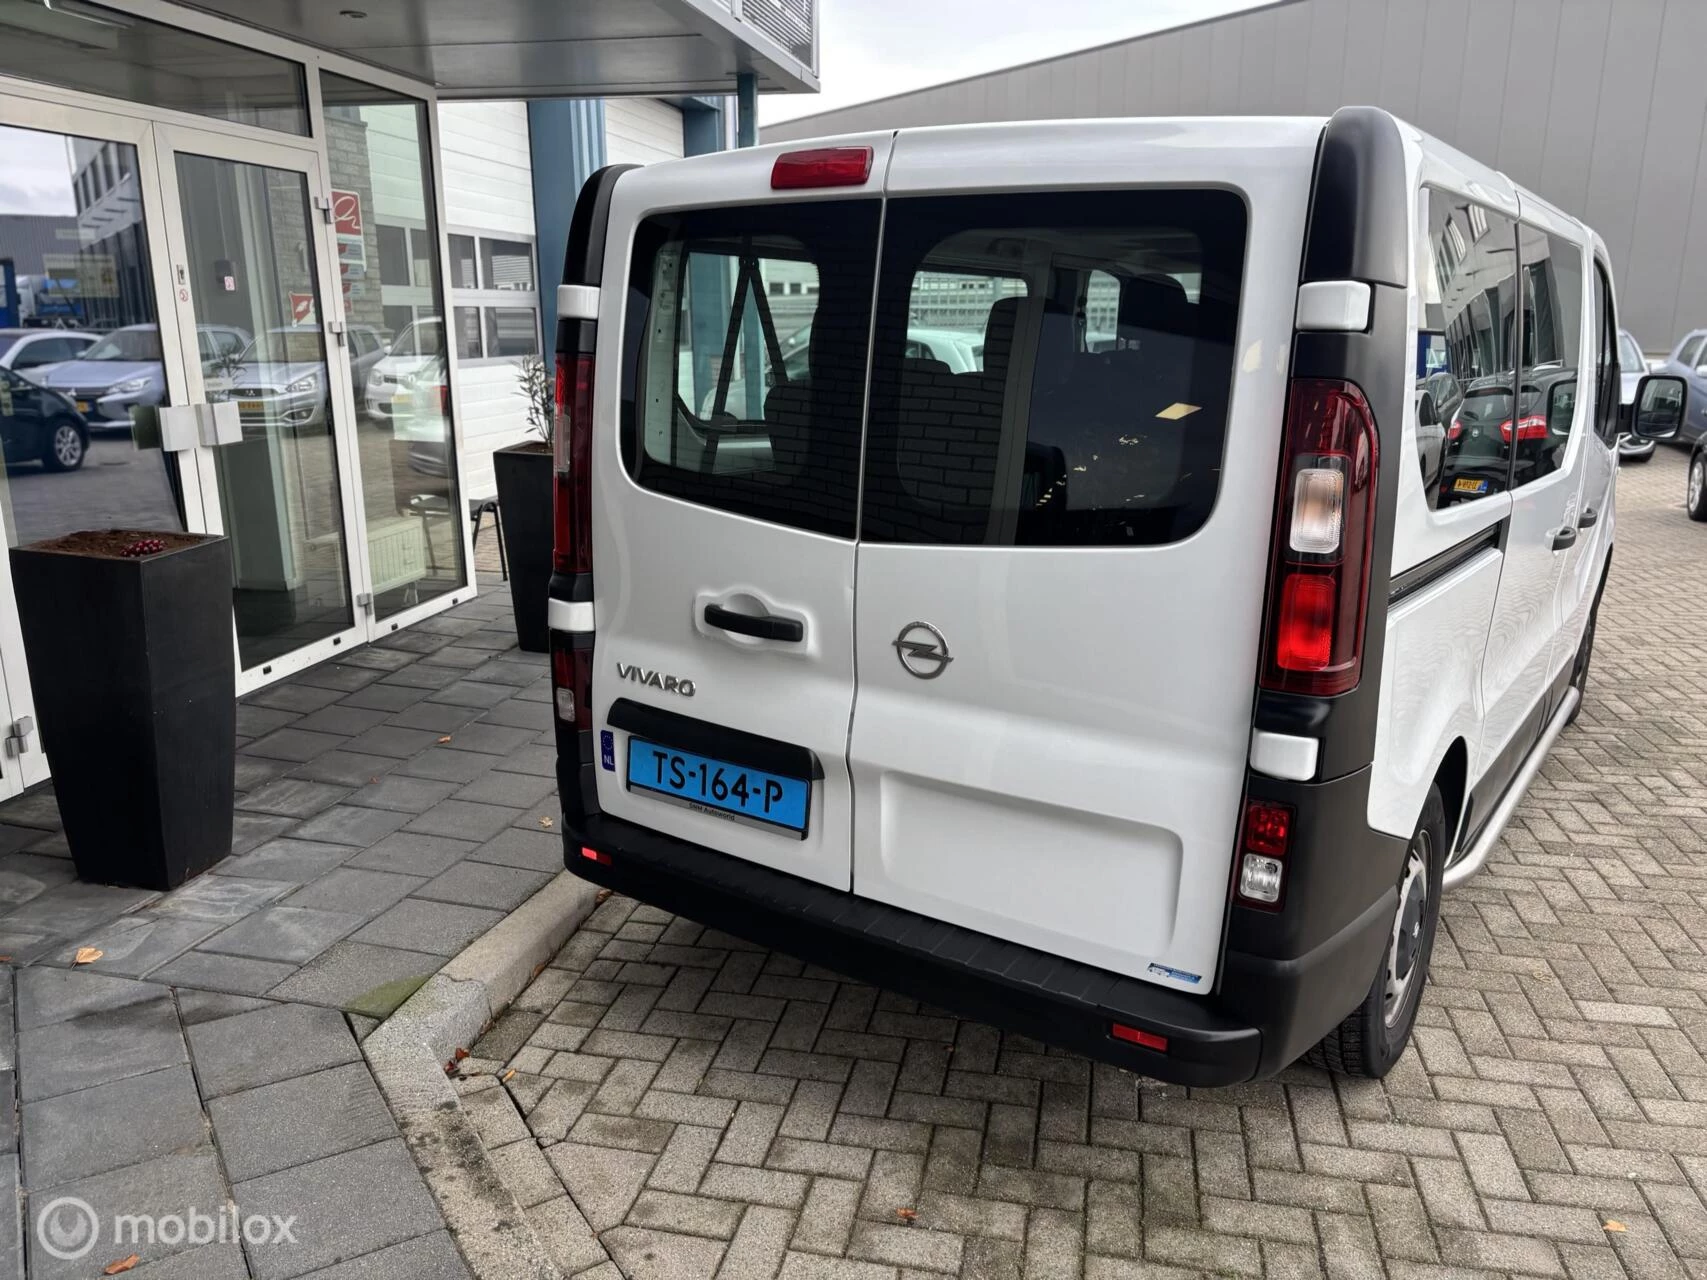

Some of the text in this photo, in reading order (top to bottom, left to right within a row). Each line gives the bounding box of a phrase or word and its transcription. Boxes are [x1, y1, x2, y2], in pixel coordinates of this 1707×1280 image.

[617, 662, 696, 697] VIVARO
[604, 754, 615, 766] NL
[653, 750, 783, 813] TS-164-P
